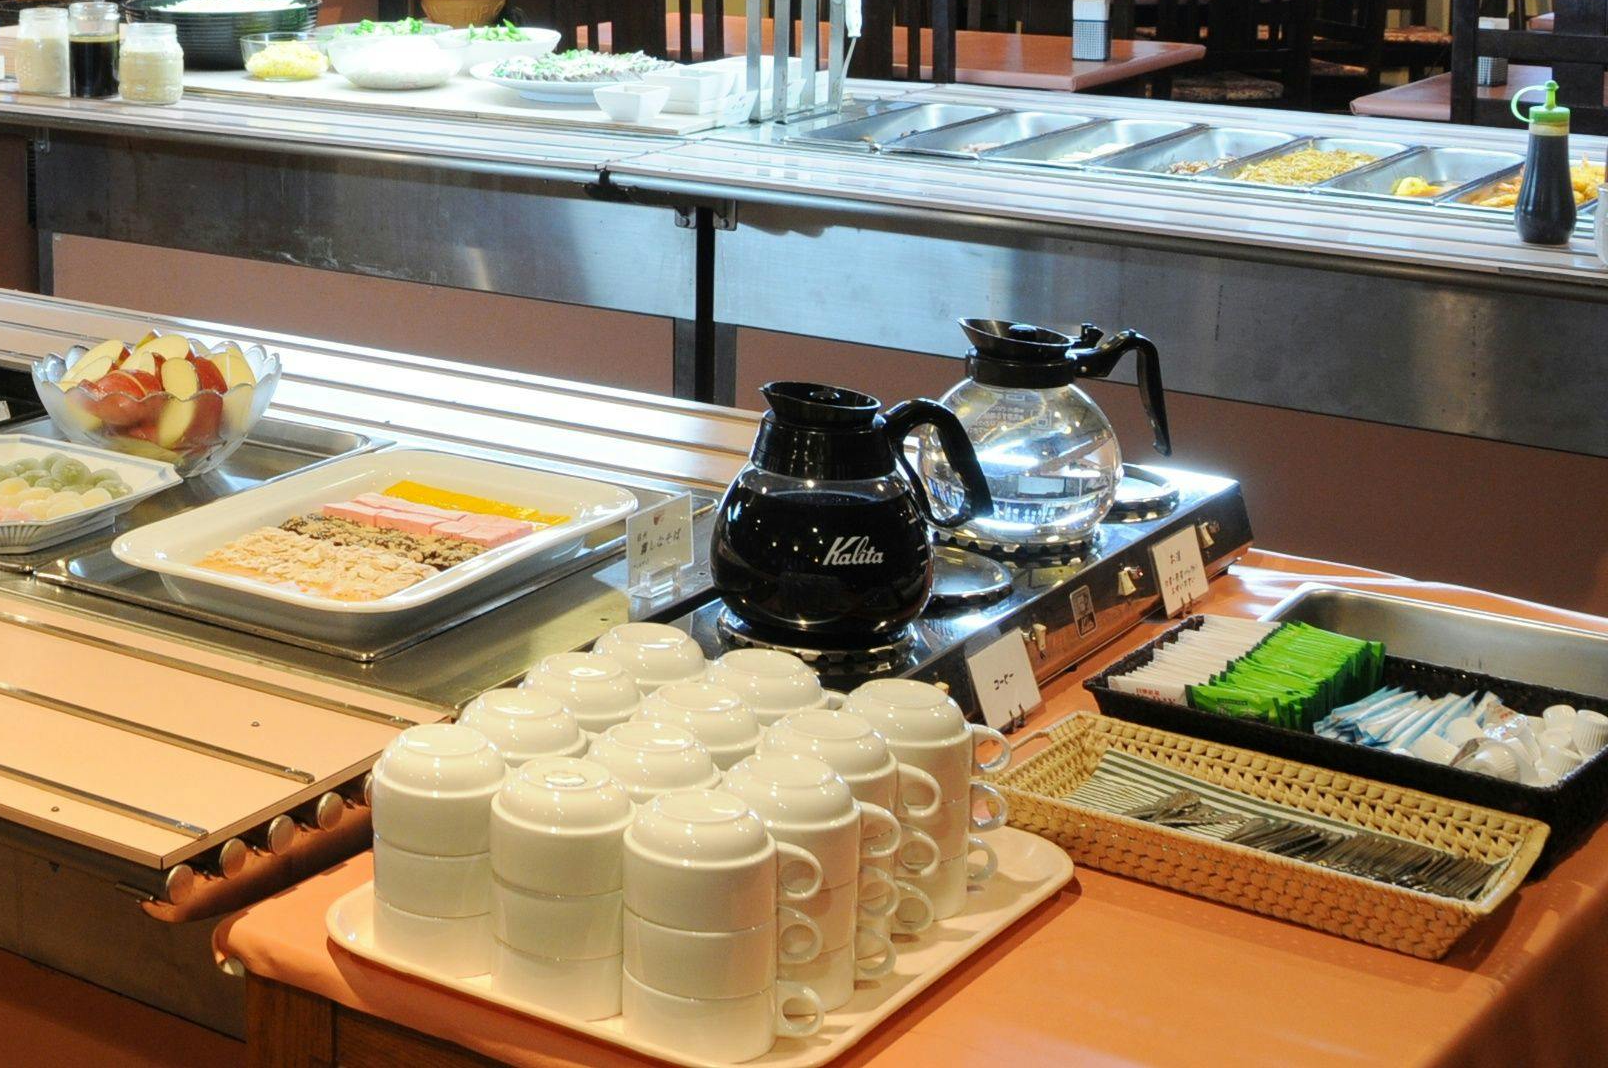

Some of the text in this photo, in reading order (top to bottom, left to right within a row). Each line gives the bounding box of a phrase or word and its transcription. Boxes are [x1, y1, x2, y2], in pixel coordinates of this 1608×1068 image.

[822, 535, 884, 566] Kalita
[993, 672, 1014, 691] コーヒー
